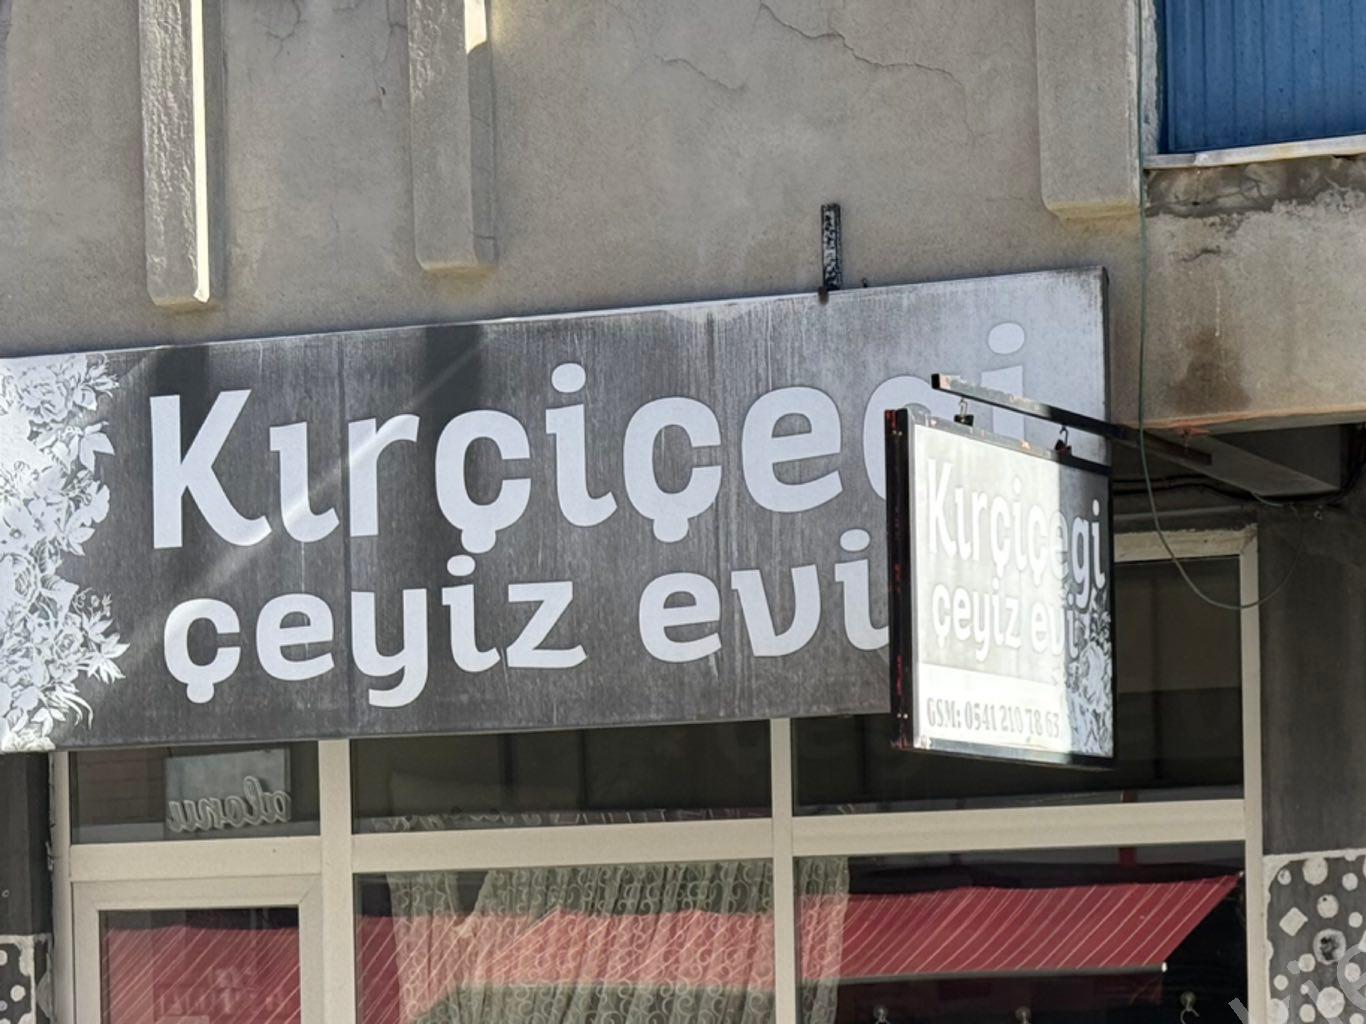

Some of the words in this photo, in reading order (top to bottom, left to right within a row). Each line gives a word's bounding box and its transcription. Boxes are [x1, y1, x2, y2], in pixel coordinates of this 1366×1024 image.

[163, 554, 588, 707] çeyiz
[638, 528, 890, 663] evi
[932, 576, 1022, 662] çeyiz
[1031, 593, 1080, 660] evi
[927, 697, 961, 729] GSM:
[964, 701, 998, 732] 0541
[1000, 704, 1023, 734] 210
[1025, 708, 1044, 737] 78
